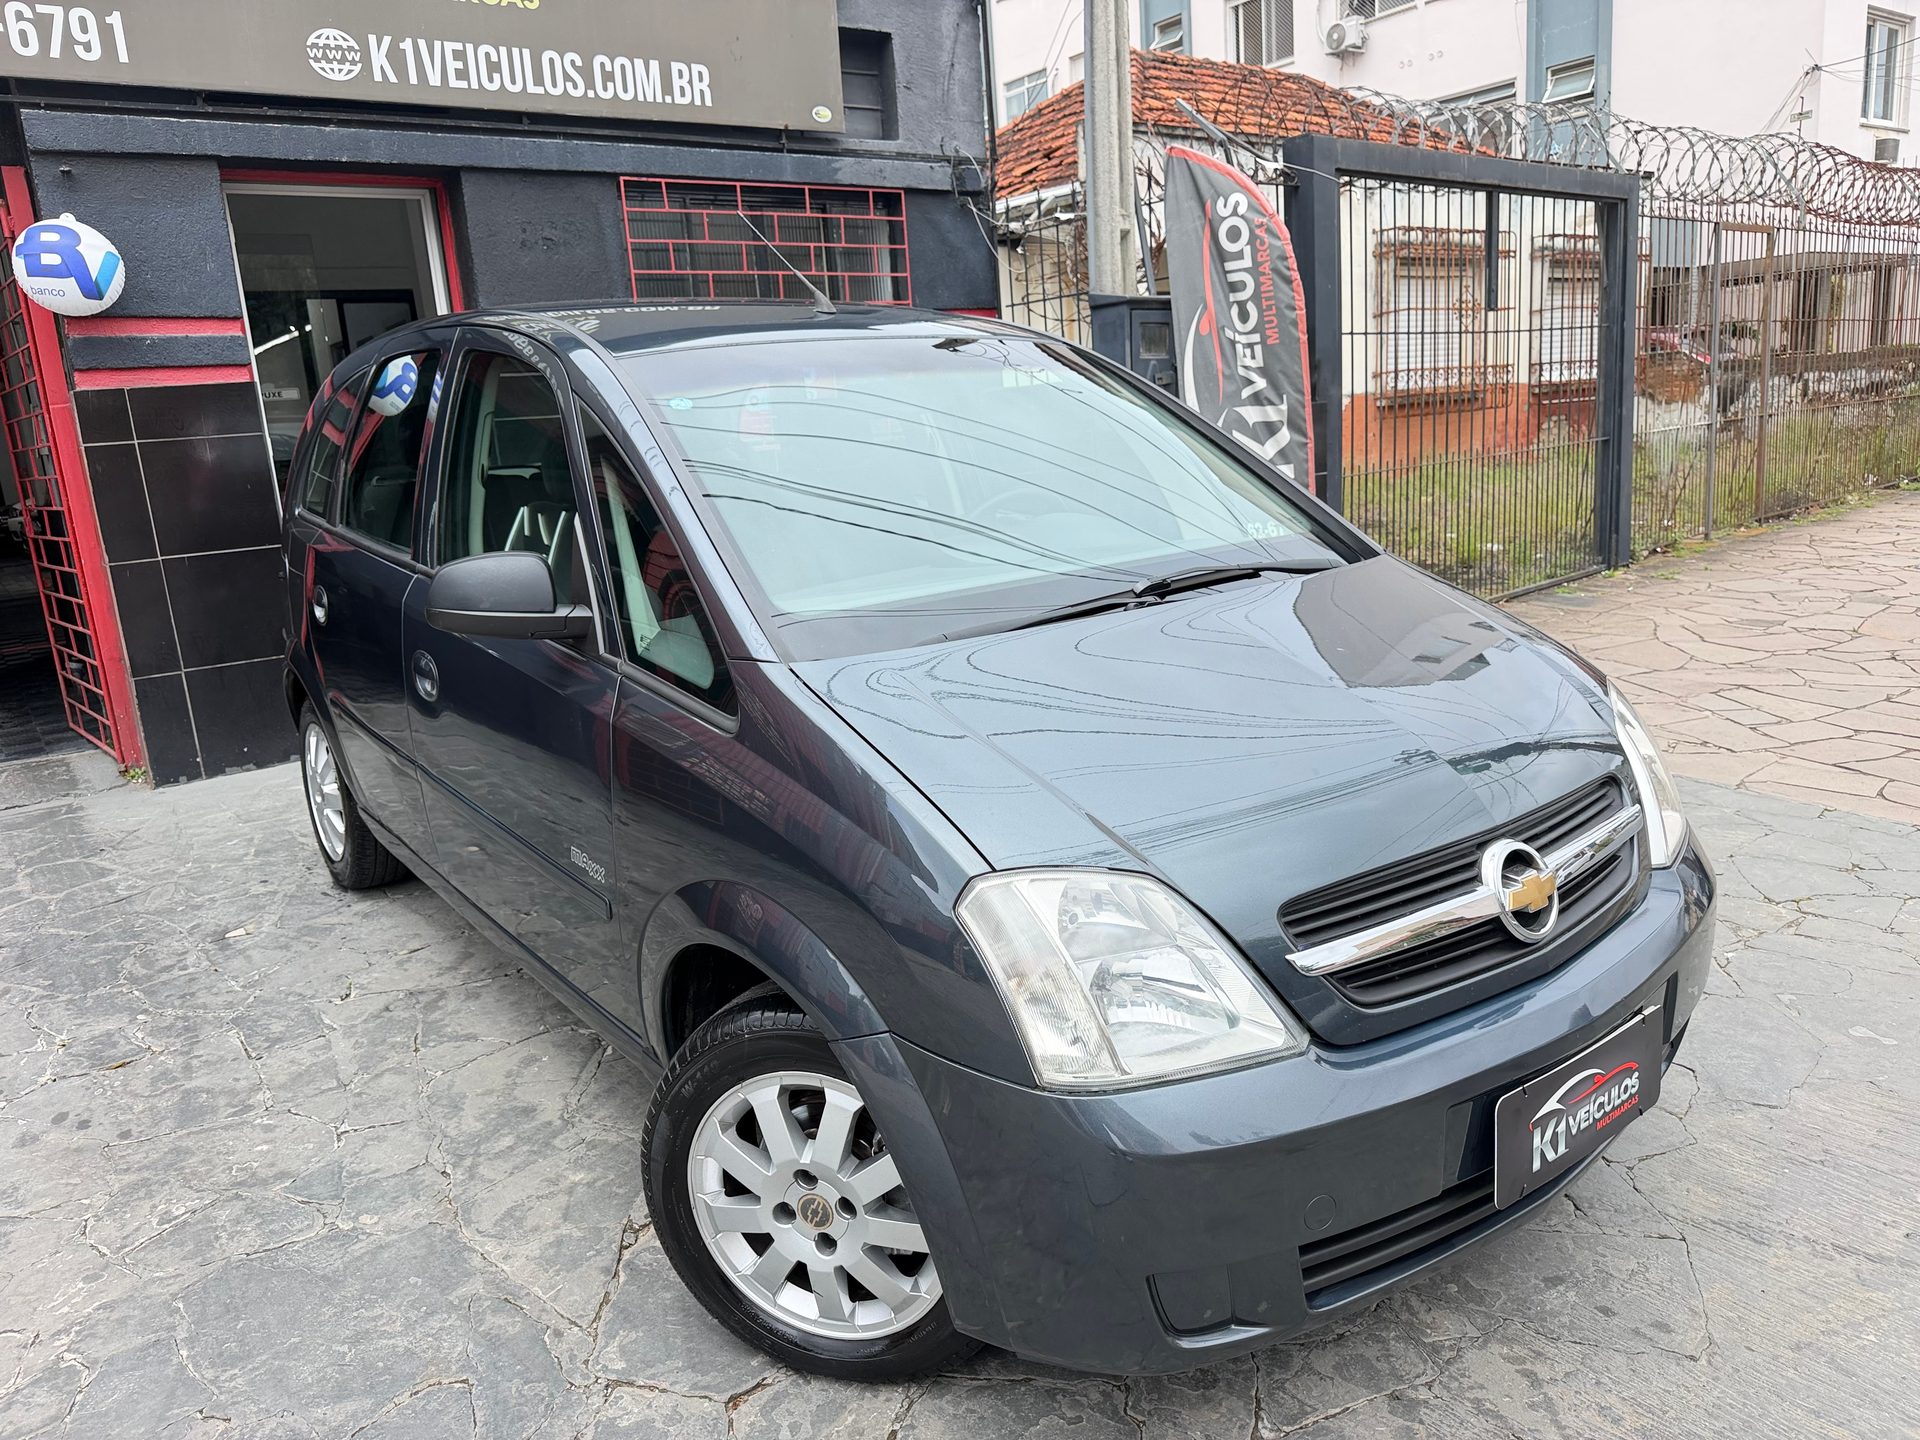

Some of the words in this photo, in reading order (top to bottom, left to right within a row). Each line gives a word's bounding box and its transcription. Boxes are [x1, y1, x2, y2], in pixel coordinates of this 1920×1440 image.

[16, 224, 121, 301] BV
[30, 286, 66, 298] banco
[1216, 191, 1268, 400] VEÍCULOS
[1254, 217, 1281, 346] MULTIMARCAS
[1532, 1112, 1569, 1174] K1
[1567, 1071, 1640, 1136] VEÍCULOS
[1596, 1094, 1640, 1132] MULTIMARCAS
